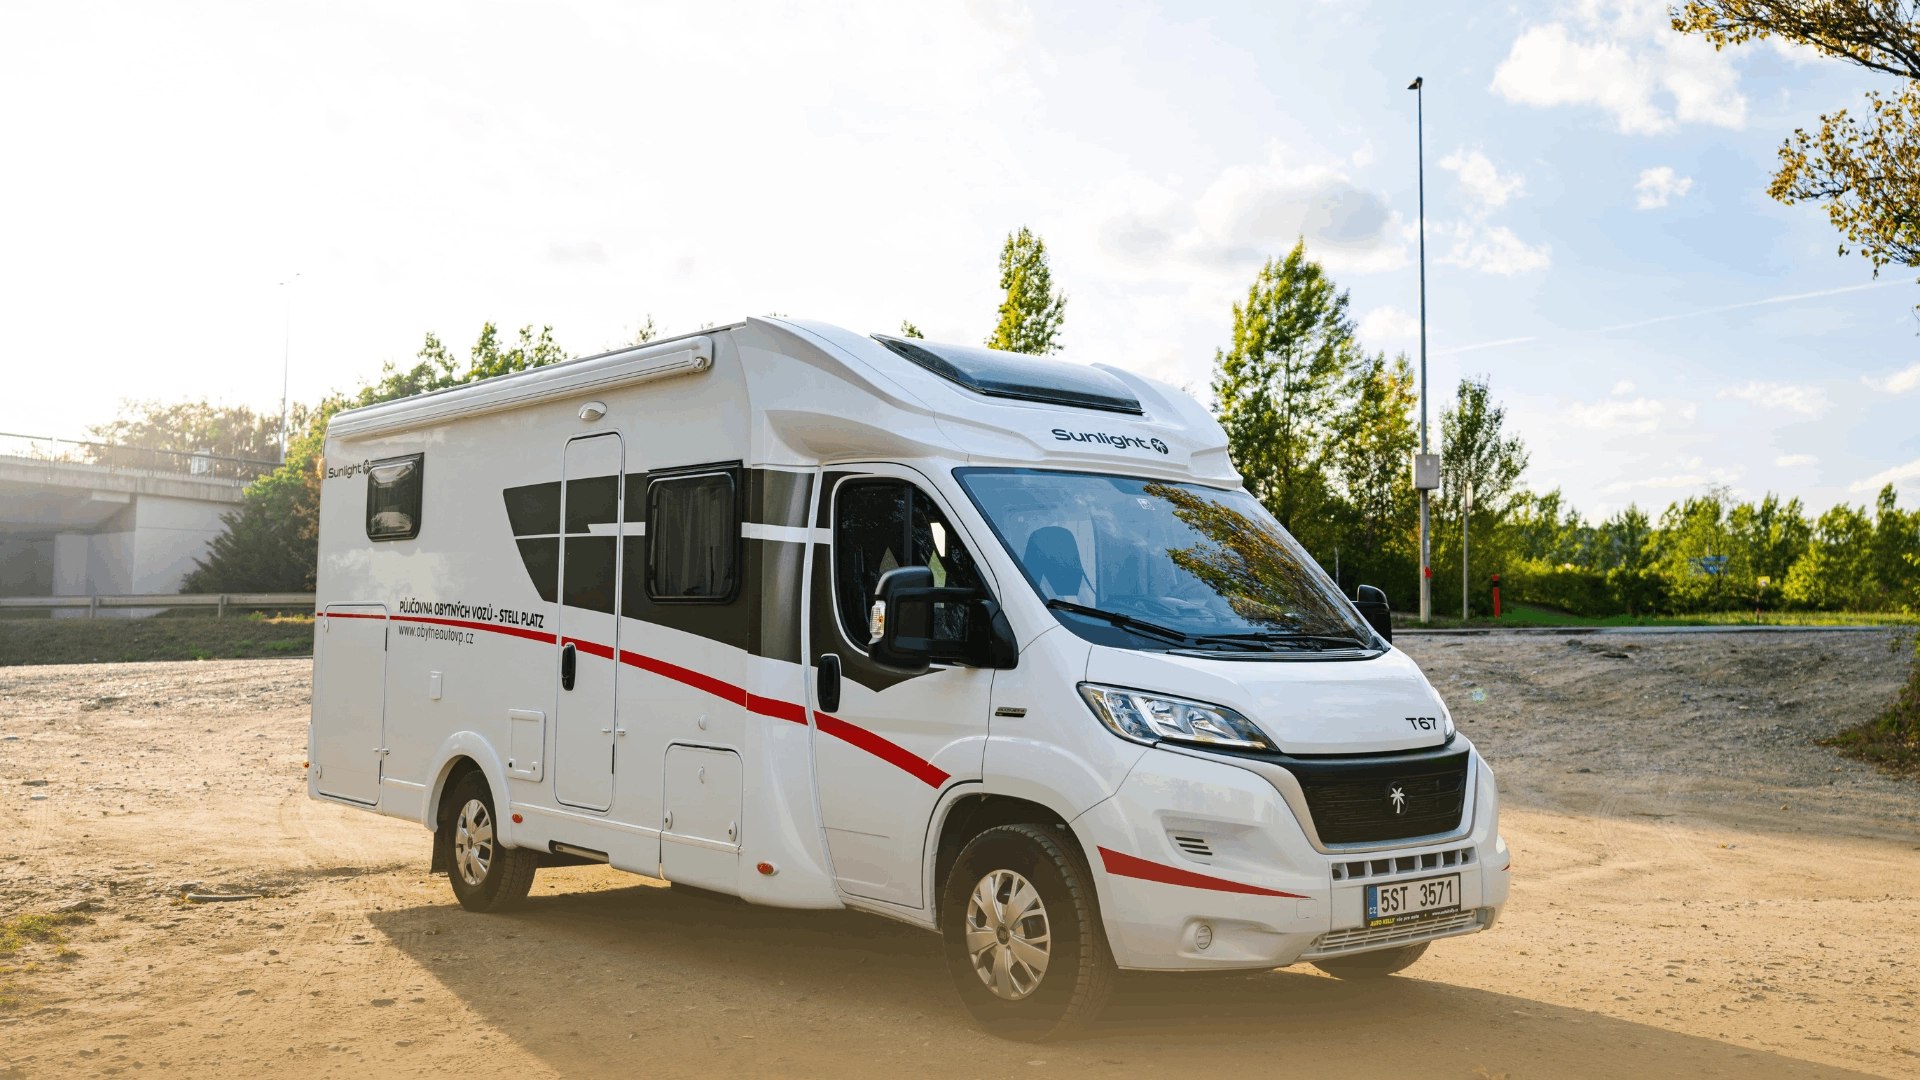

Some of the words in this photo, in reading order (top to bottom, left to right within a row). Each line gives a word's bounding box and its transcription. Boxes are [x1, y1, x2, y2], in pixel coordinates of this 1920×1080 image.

[1051, 428, 1151, 450] Sunlight
[328, 463, 362, 479] Sunlight
[399, 597, 433, 615] PŮJČOVNA
[434, 600, 471, 619] OBYTNÝCH
[472, 603, 493, 621] VOZŮ
[499, 609, 519, 625] STELL
[521, 611, 544, 628] PLATZ
[398, 624, 474, 646] www.obytneautovp.cz
[1405, 717, 1437, 730] T67
[1381, 886, 1408, 913] 5ST
[1419, 880, 1452, 907] 3571
[1368, 906, 1377, 915] CZ
[1370, 919, 1382, 927] AUTO
